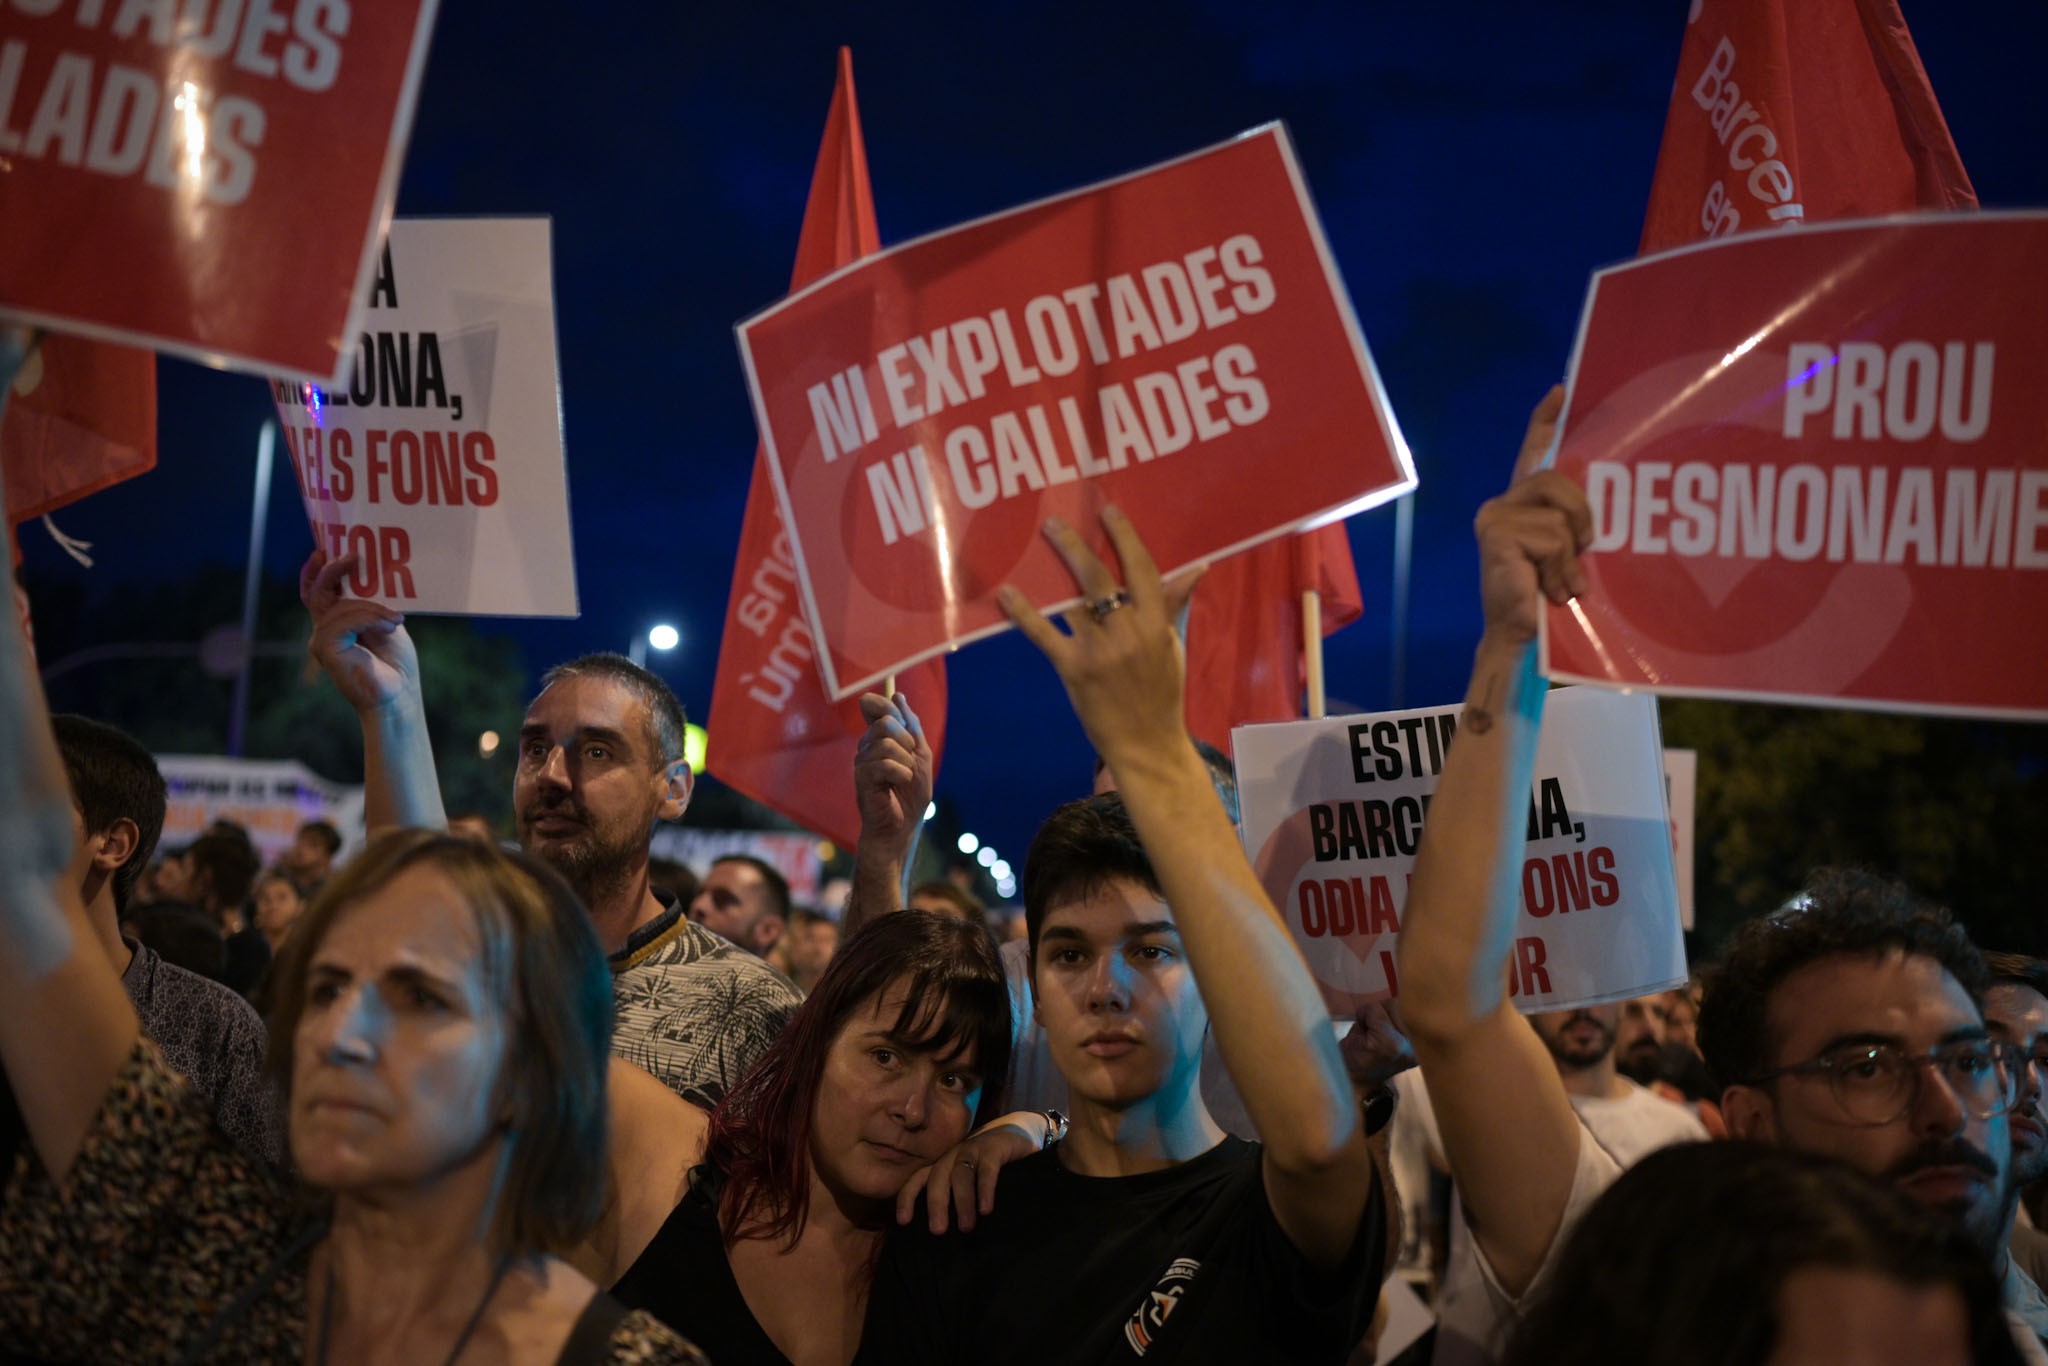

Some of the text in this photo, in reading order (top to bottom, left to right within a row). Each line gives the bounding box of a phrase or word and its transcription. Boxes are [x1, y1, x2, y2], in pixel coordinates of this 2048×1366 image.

[1692, 35, 1804, 232] Barcel
[807, 233, 1277, 464] NI EXPLOTADES
[1782, 340, 1996, 443] PROU
[366, 429, 499, 508] FONS
[865, 343, 1271, 546] NI CALLADES
[1584, 459, 2048, 570] DESNONAME
[1298, 846, 1621, 939] ODIA ONS
